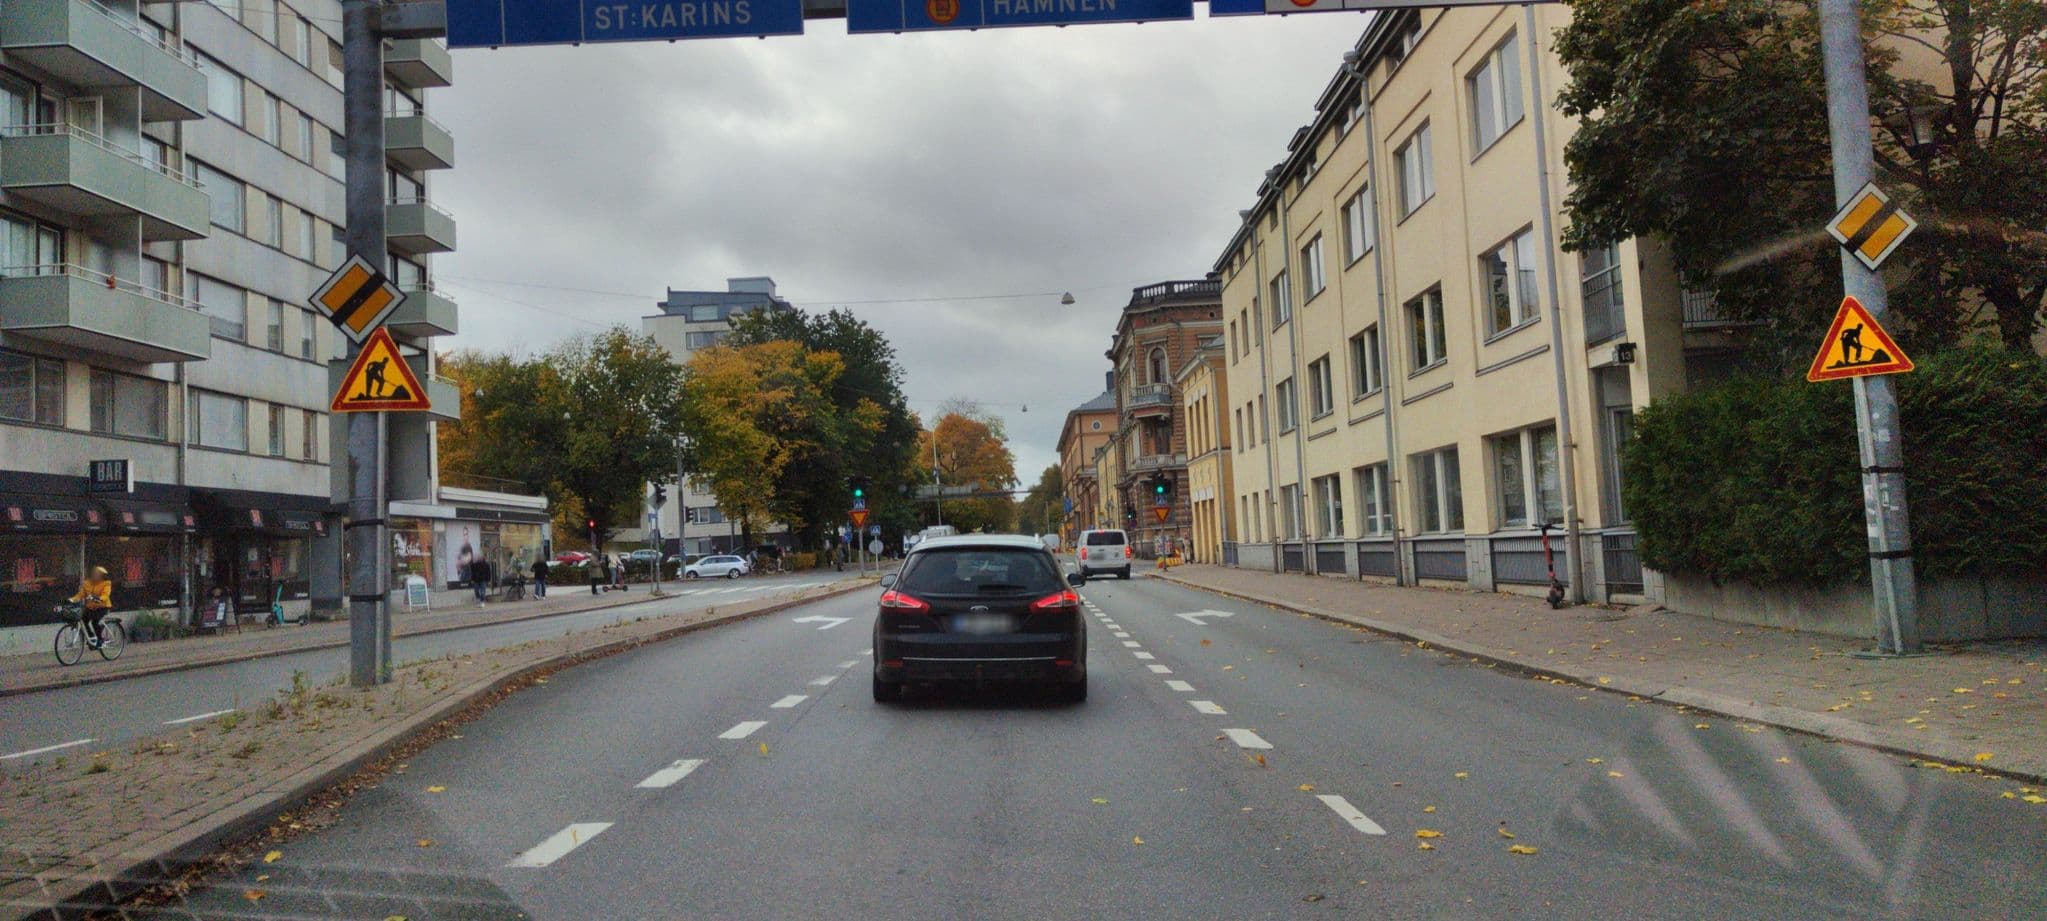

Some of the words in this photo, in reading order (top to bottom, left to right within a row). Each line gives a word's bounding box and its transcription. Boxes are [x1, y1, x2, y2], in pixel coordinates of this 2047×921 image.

[595, 1, 751, 29] ST:KARINS
[1621, 351, 1632, 361] 13
[97, 462, 122, 481] BAR
